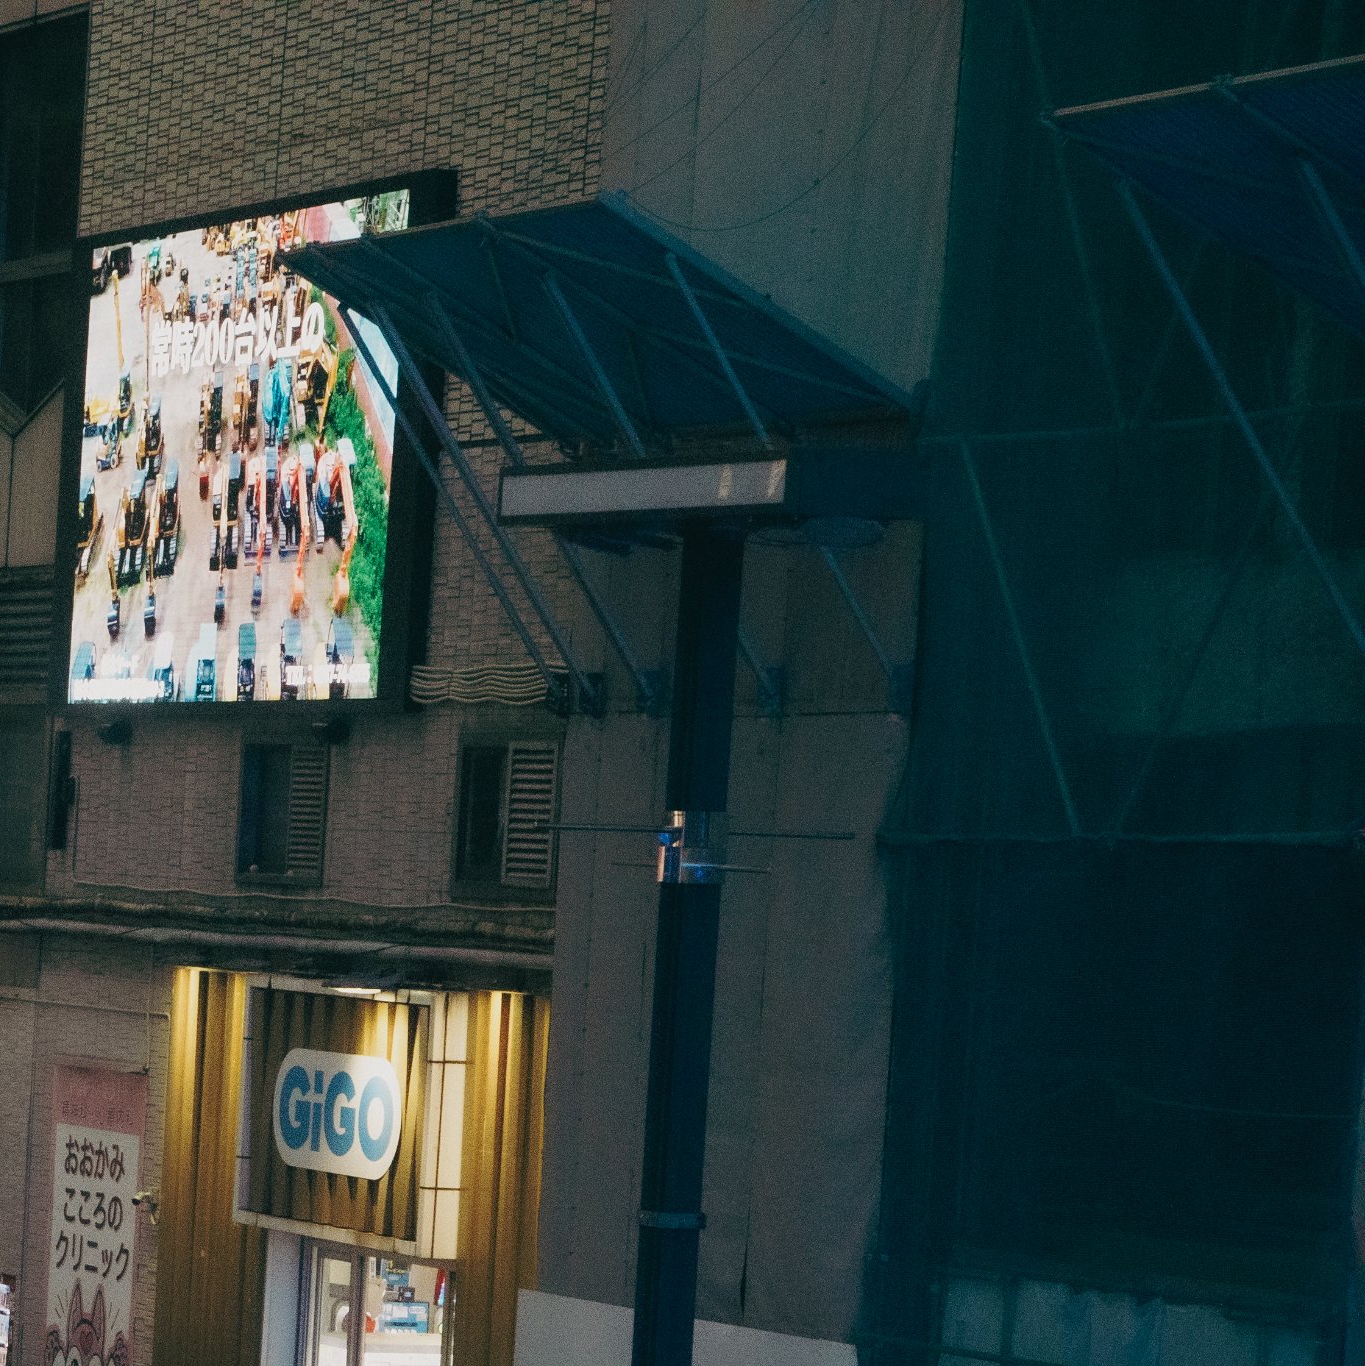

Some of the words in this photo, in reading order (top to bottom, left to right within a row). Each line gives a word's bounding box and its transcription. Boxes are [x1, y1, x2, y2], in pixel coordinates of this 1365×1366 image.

[151, 301, 325, 378] 常時200台以上の
[279, 1065, 394, 1162] GiGO
[65, 1135, 125, 1182] おおかみ
[63, 1187, 124, 1231] こころの
[56, 1229, 130, 1281] クリニック
